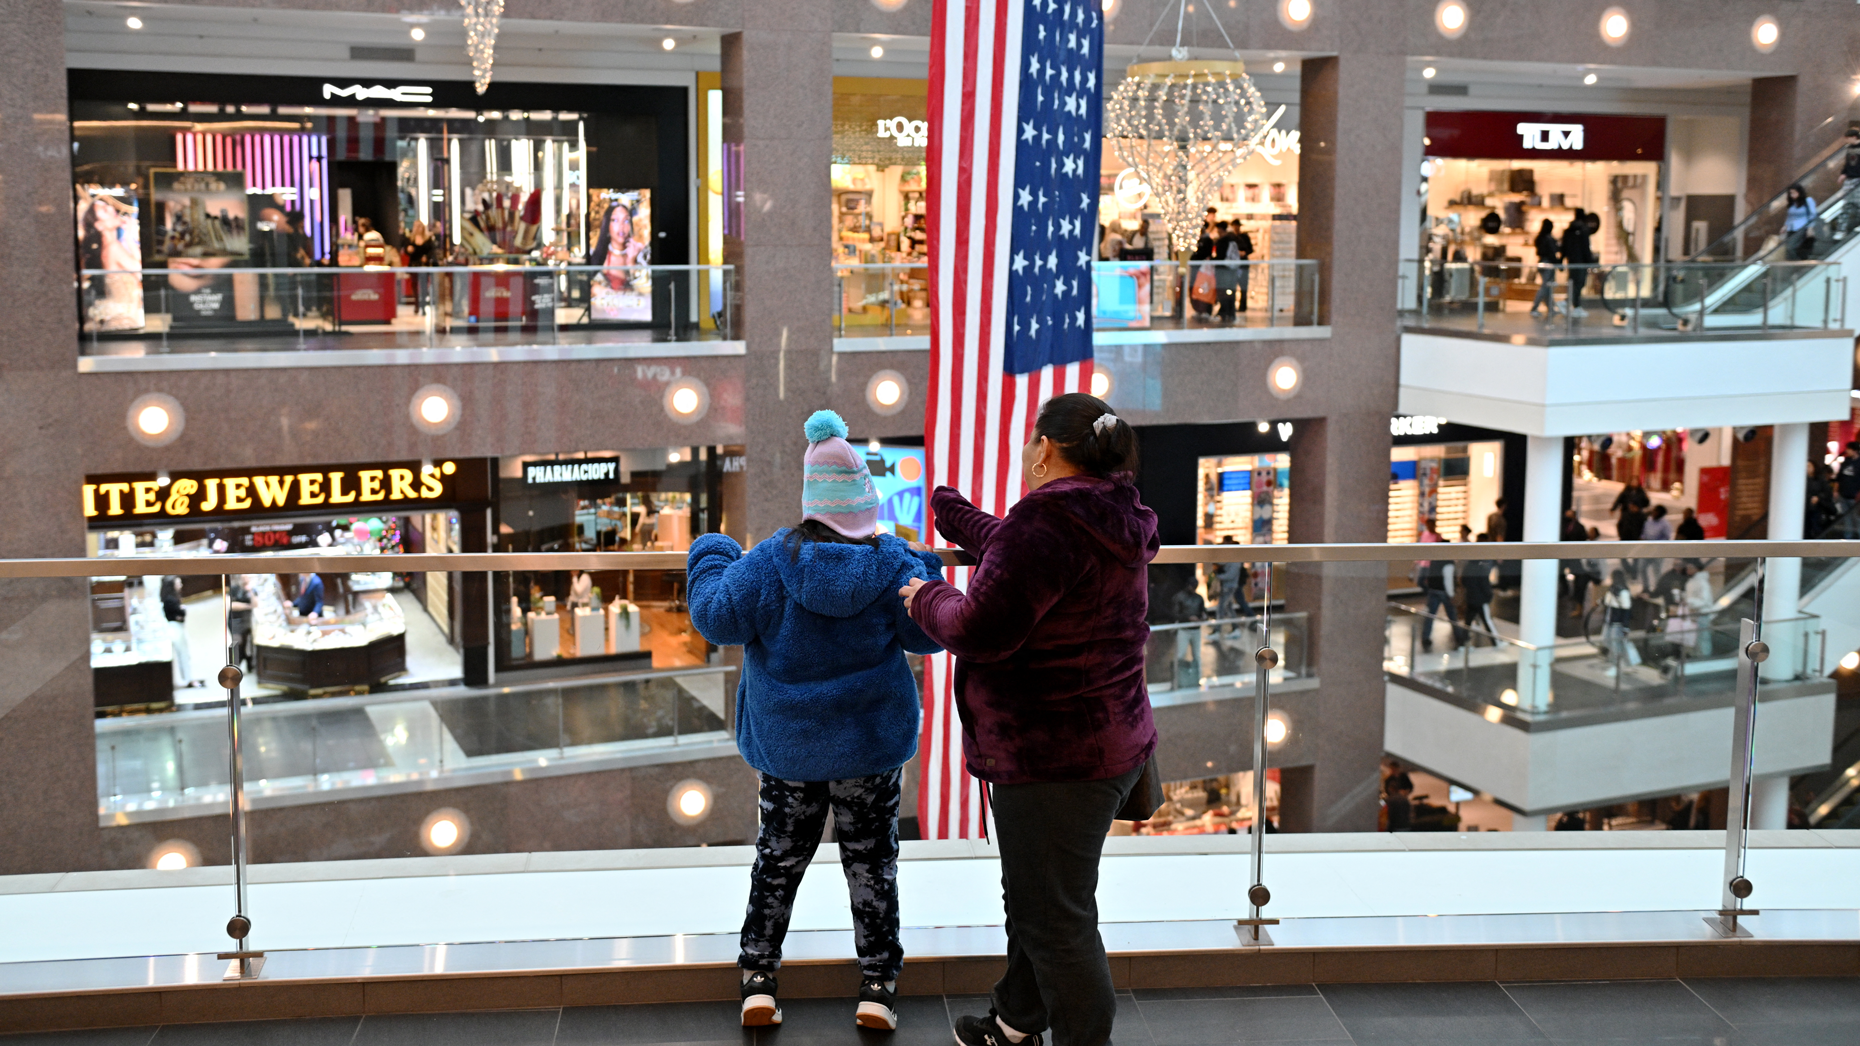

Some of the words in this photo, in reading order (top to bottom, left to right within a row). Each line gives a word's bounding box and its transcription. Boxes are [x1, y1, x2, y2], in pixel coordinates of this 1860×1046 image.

[323, 83, 433, 102] MAC
[527, 461, 617, 484] PHARMACIOPY
[82, 481, 162, 517] ITE
[164, 478, 199, 515] &
[200, 467, 444, 512] JEWELERS
